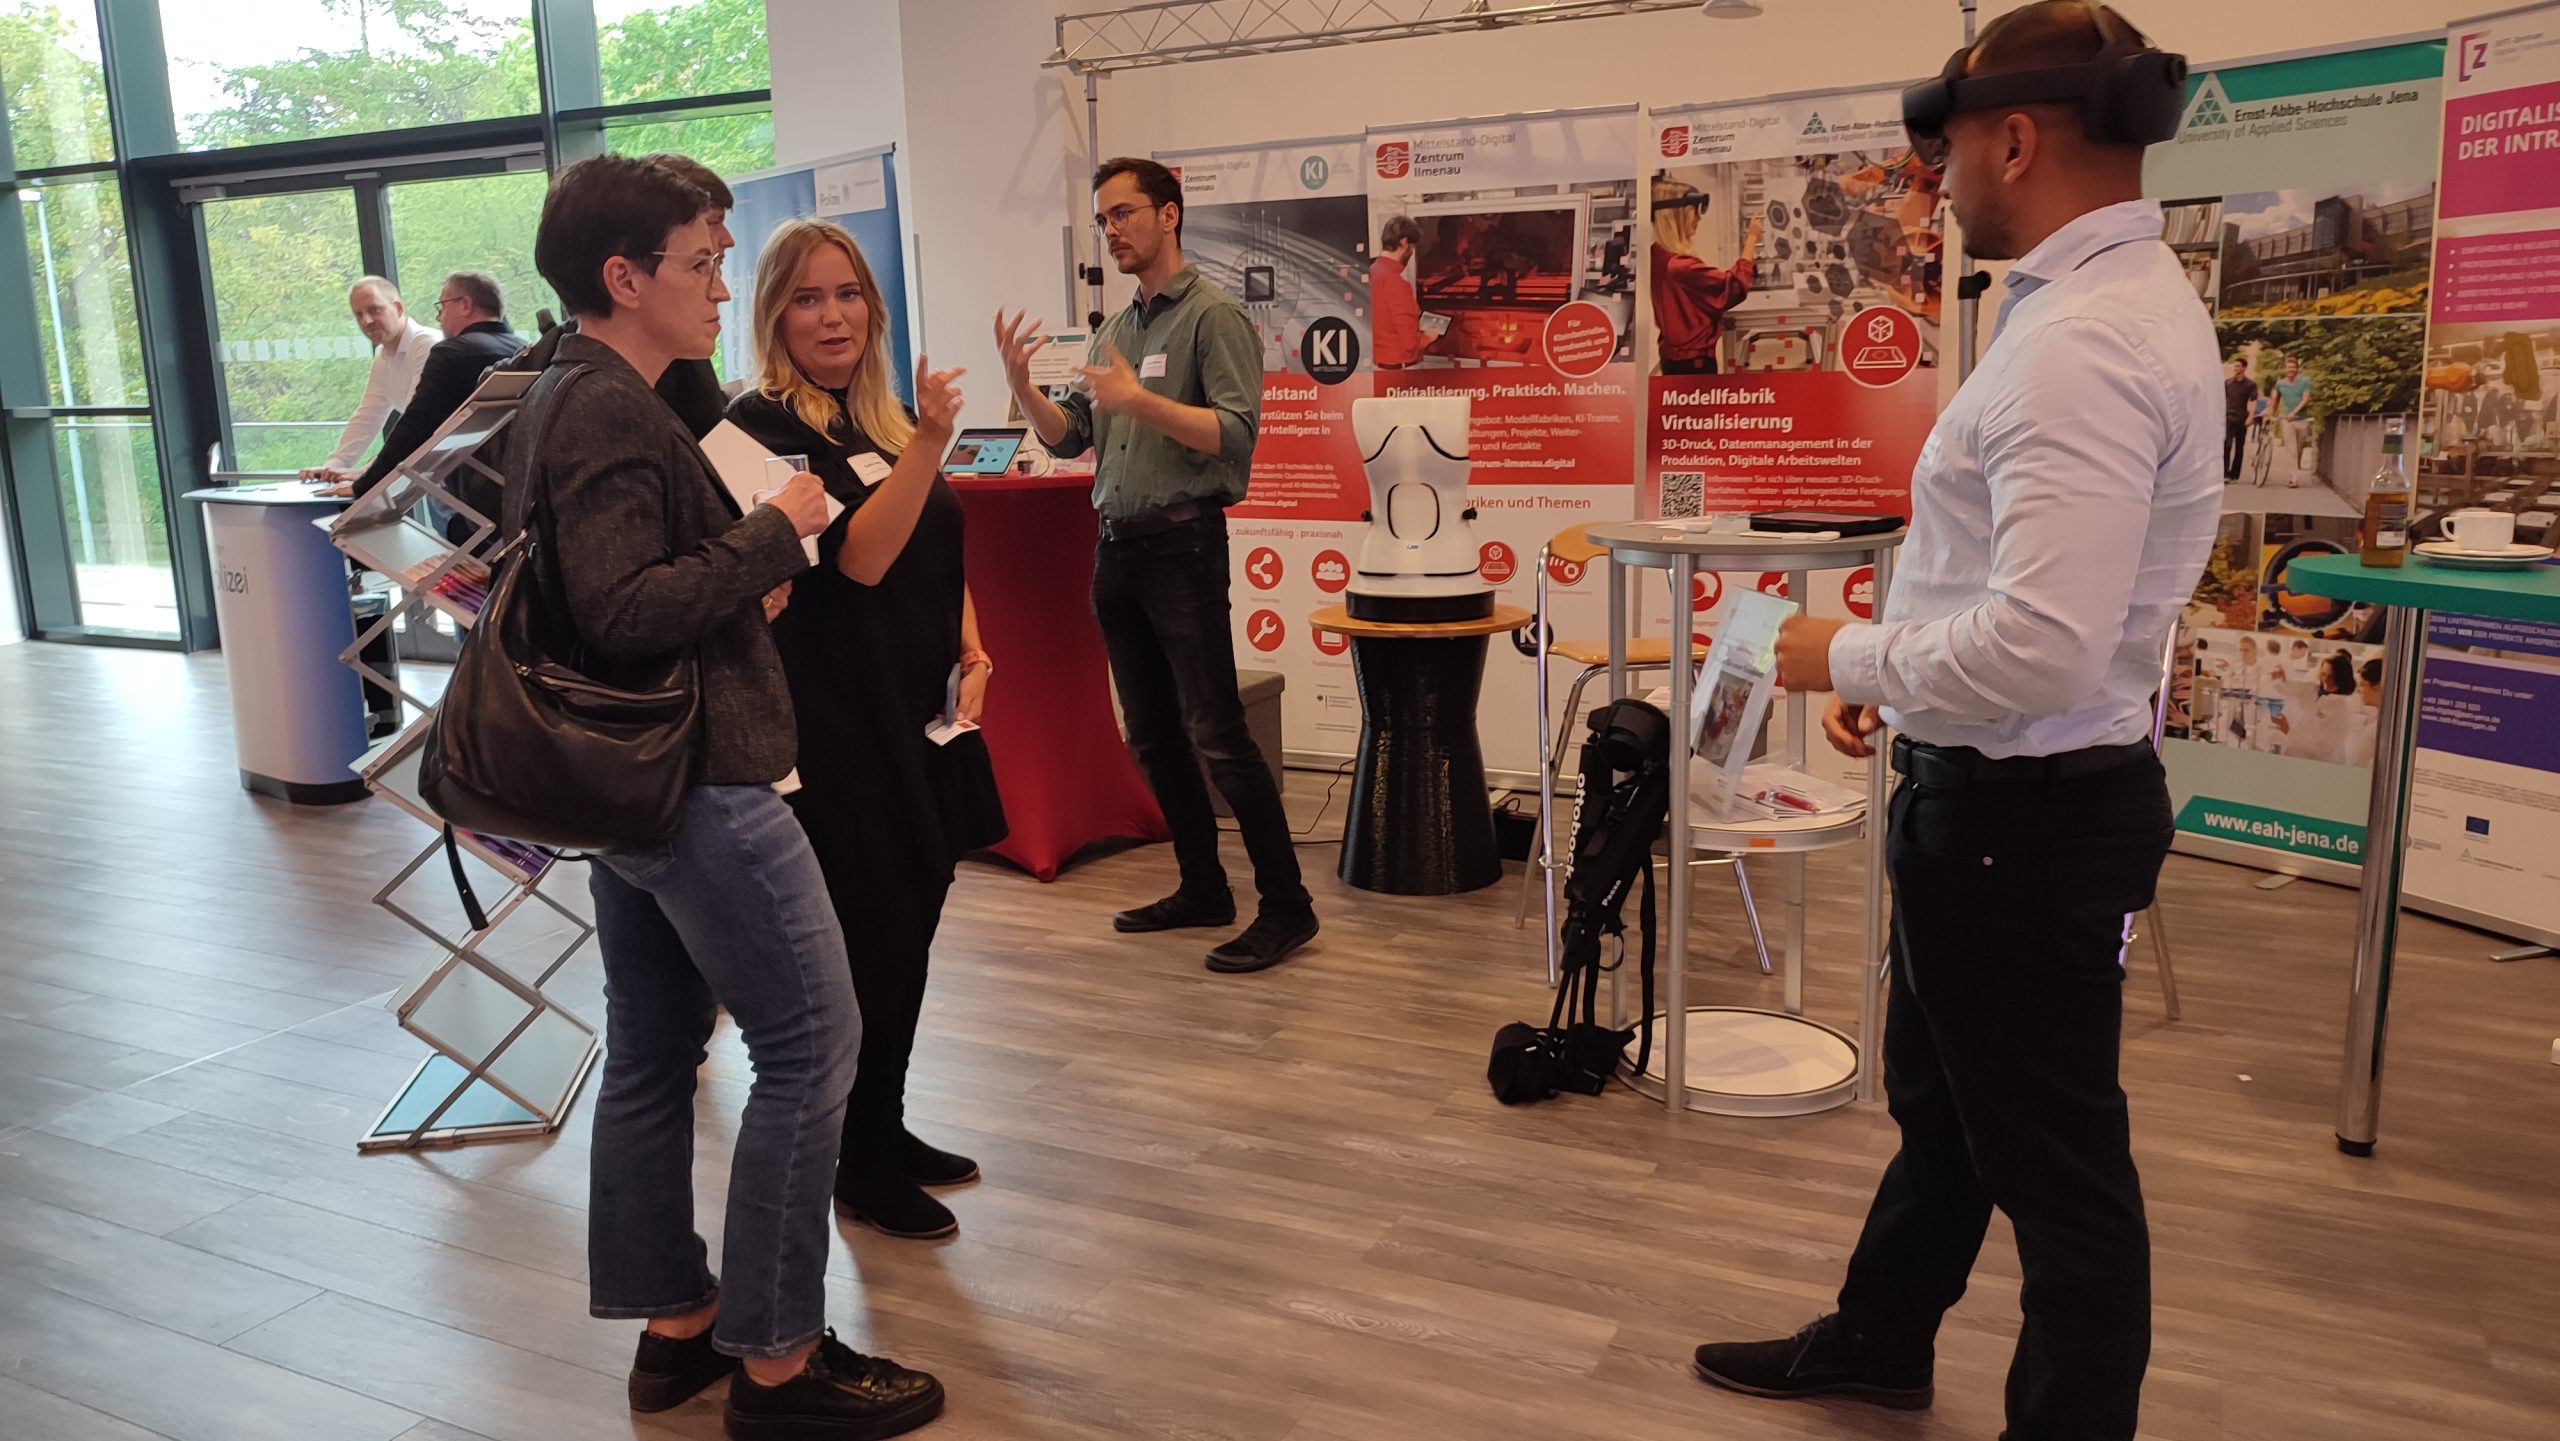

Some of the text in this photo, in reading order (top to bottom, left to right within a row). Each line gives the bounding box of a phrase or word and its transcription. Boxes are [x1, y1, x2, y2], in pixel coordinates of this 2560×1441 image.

[2234, 90, 2419, 122] Ernst-Abbe-Hochschule Jena
[2177, 115, 2348, 145] University of Applied Sciences
[1413, 132, 1516, 150] Mittelstand-Digital
[1692, 133, 1735, 144] Zentrum
[2458, 129, 2560, 160] DER INTR
[1692, 145, 1732, 155] Ilmenau
[1413, 151, 1464, 164] Zentrum
[1305, 162, 1323, 180] KI
[1413, 166, 1461, 178] Ilmenau
[1184, 174, 1217, 183] Zentrum
[1313, 329, 1348, 365] KI
[1262, 386, 1318, 400] elstand
[1386, 383, 1626, 401] Digitalisierung. Praktisch. Machen.
[1662, 387, 1776, 406] Modellfabrik
[1304, 410, 1319, 420] Sie
[1320, 410, 1344, 420] beim
[1505, 414, 1574, 425] Modellfabriken,
[1661, 414, 1793, 433] Virtualisierung
[1269, 425, 1320, 437] Intelligenz
[1321, 425, 1331, 435] in
[1511, 428, 1549, 438] Projekte,
[1551, 428, 1583, 437] Weiter-
[1482, 442, 1500, 450] und
[1501, 442, 1542, 450] Kontakte
[1661, 438, 1873, 452] 3D-Druck, Datenmanagement in der
[1661, 455, 1861, 468] Produktion, Digitale Arbeitswelten
[1507, 496, 1534, 509] und
[1537, 496, 1591, 509] Themen
[1235, 528, 1343, 539] zukunftsfähig praxisnah
[2203, 811, 2360, 854] www.eah-jena.de
